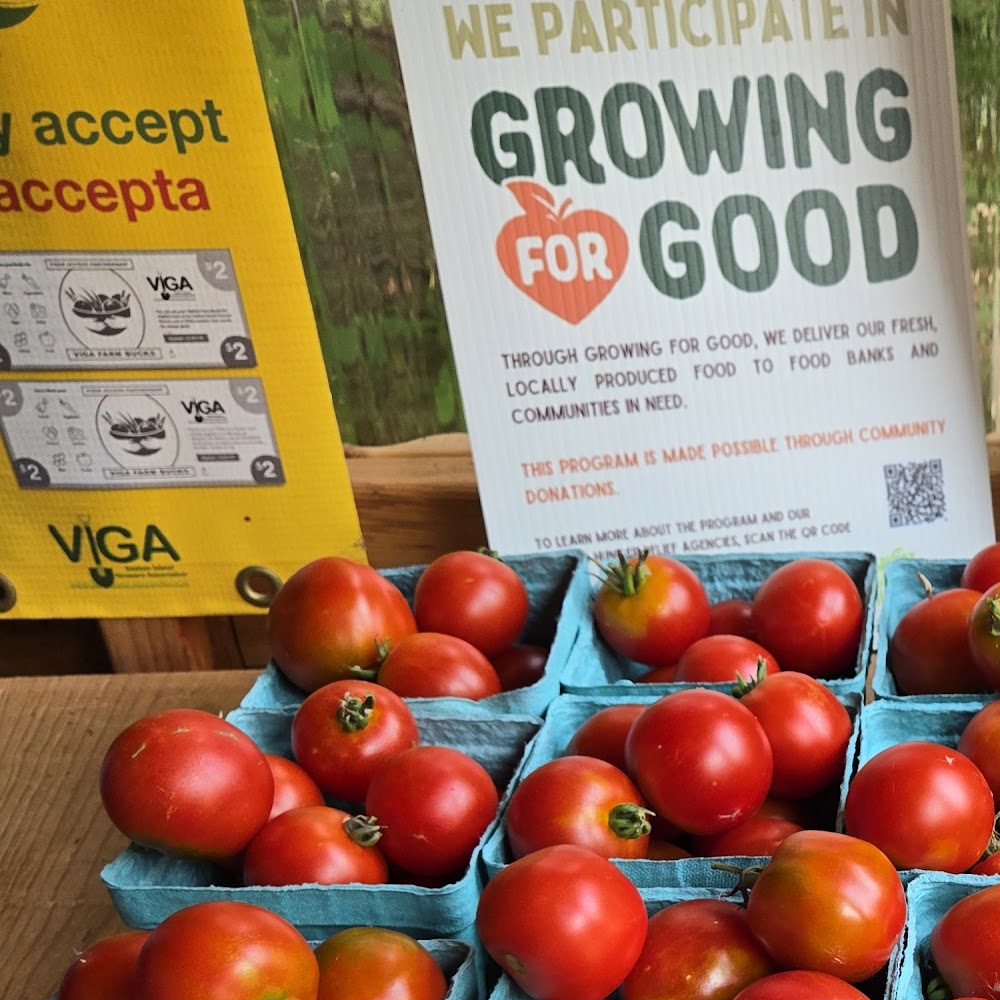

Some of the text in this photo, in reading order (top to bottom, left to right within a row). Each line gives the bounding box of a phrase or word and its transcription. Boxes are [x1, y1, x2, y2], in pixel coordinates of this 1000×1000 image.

[444, 0, 909, 60] WE PARTICIPATE IN
[31, 98, 229, 155] accept
[470, 67, 912, 187] GROWING
[0, 169, 211, 223] accepta
[515, 183, 919, 299] FOR GOOD
[146, 274, 194, 295] VIGA
[204, 260, 229, 280] $2
[223, 341, 249, 361] $2
[502, 315, 938, 369] THROUGH GROWING FOR GOOD, WE DELIVER OUR FRESH,
[506, 341, 940, 398] LOCALLY PRODUCED FOOD TO FOOD BANKS AND
[181, 399, 226, 418] VIGA
[511, 393, 688, 425] COMMUNITIES IN NEED.
[255, 459, 278, 479] $2
[521, 418, 947, 479] THIS PROGRAM IS MADE POSSIBLE THROUGH COMMUNITY
[19, 462, 43, 481] $2
[525, 480, 620, 506] DONATIONS.
[47, 521, 181, 574] VIGA
[535, 507, 811, 550] TO LEARN MORE ABOUT THE PROGRAM AND OUR
[683, 535, 742, 552] AGENCIES,
[745, 530, 775, 546] SCAN
[779, 528, 798, 542] THE
[802, 525, 819, 539] QR
[822, 521, 852, 536] CODE
